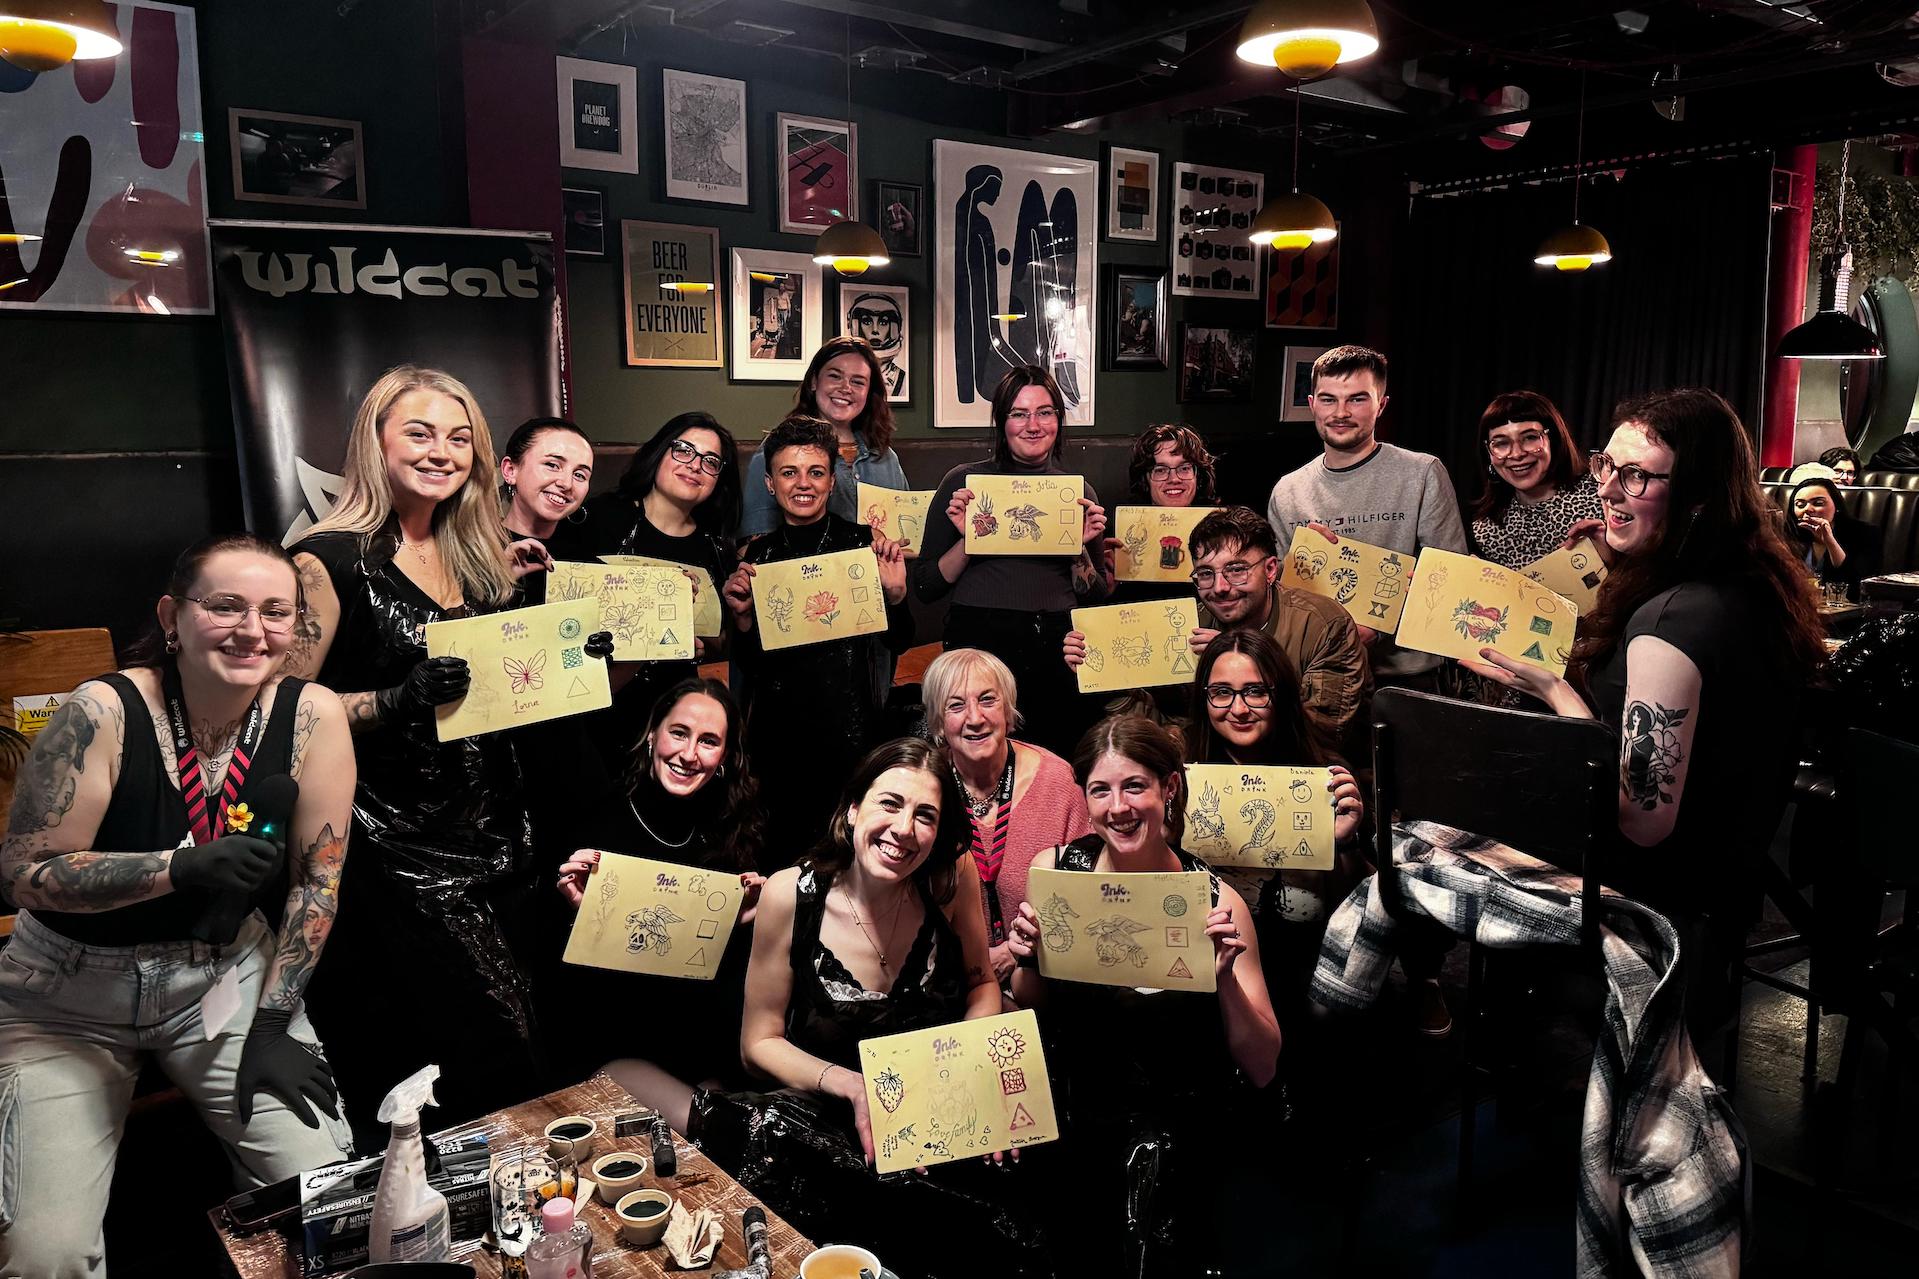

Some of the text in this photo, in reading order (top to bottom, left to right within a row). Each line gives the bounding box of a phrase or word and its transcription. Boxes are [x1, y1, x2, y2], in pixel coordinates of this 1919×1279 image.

[584, 103, 607, 117] PLANET
[581, 113, 611, 127] BREWDOG
[652, 240, 688, 271] BEER
[658, 273, 686, 302] FOR
[637, 303, 708, 334] EVERYONE
[1348, 512, 1406, 525] HILFIGER
[1341, 527, 1357, 535] 1985
[1241, 774, 1266, 786] Ink.
[656, 873, 680, 887] Ink.
[1101, 883, 1131, 896] Ink.
[308, 1255, 325, 1272] XS
